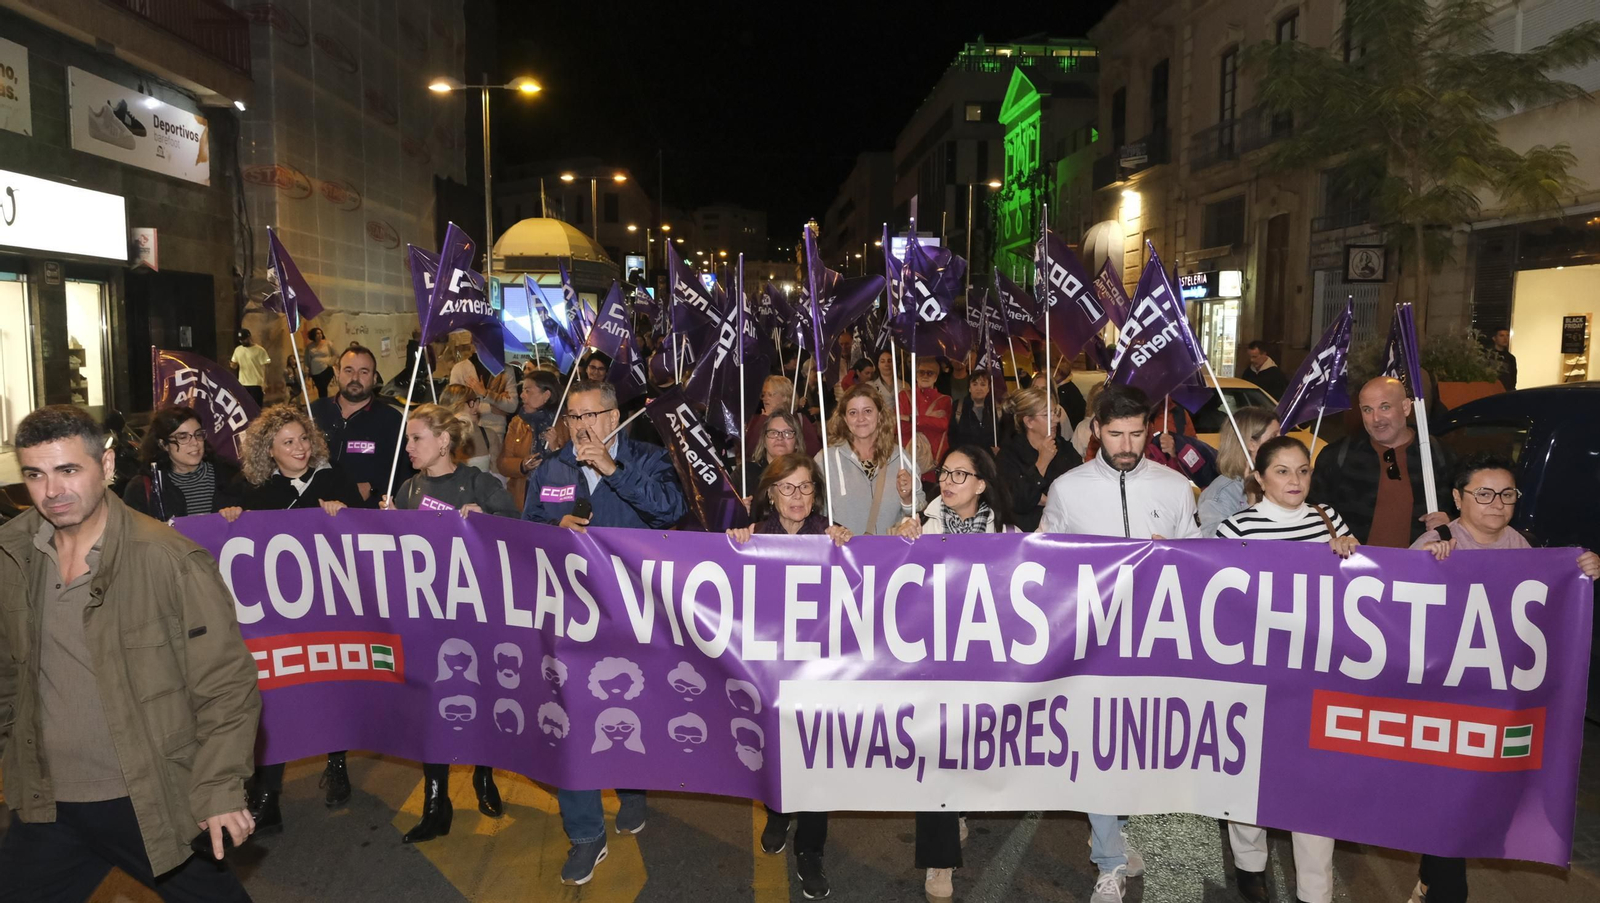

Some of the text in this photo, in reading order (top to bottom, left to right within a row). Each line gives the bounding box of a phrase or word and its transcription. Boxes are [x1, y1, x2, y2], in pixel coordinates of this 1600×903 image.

[153, 114, 199, 143] Deportivos
[665, 412, 718, 486] Almería
[541, 487, 575, 497] CCOO
[219, 532, 1549, 692] CONTRA LAS VIOLENCIAS MACHISTAS
[794, 694, 1248, 784] VIVAS, LIBRES, UNIDAS
[1325, 704, 1496, 759] CCOO
